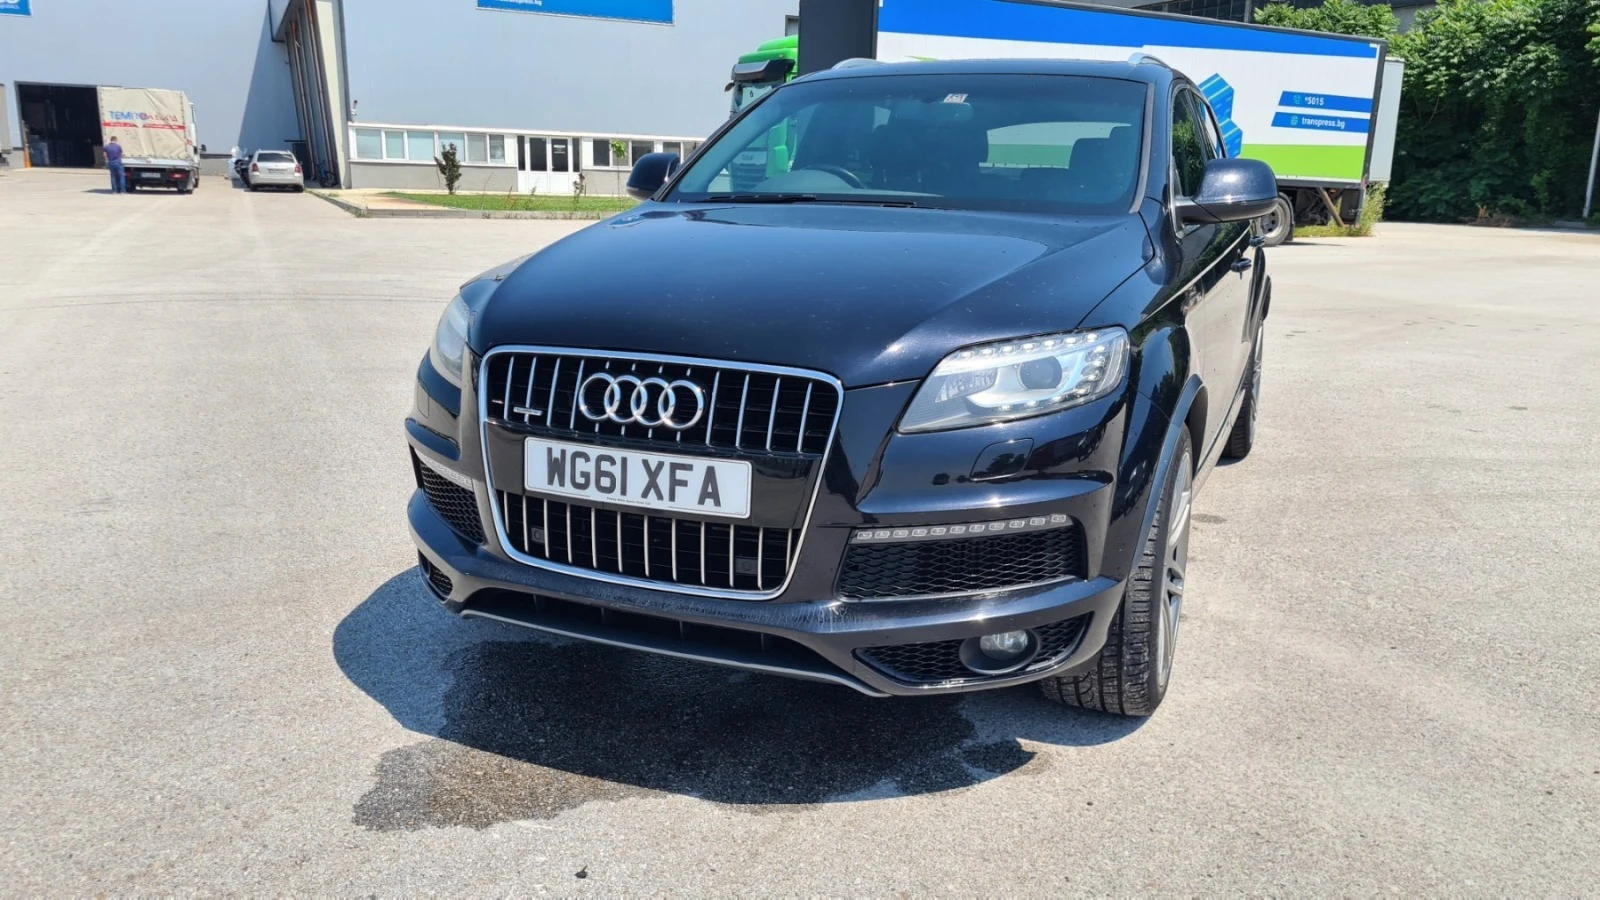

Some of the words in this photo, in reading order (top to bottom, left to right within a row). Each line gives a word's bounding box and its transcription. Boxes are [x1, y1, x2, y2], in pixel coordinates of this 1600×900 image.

[1301, 117, 1346, 129] transpress.bg
[547, 447, 627, 496] WG61
[641, 459, 721, 507] XFA
